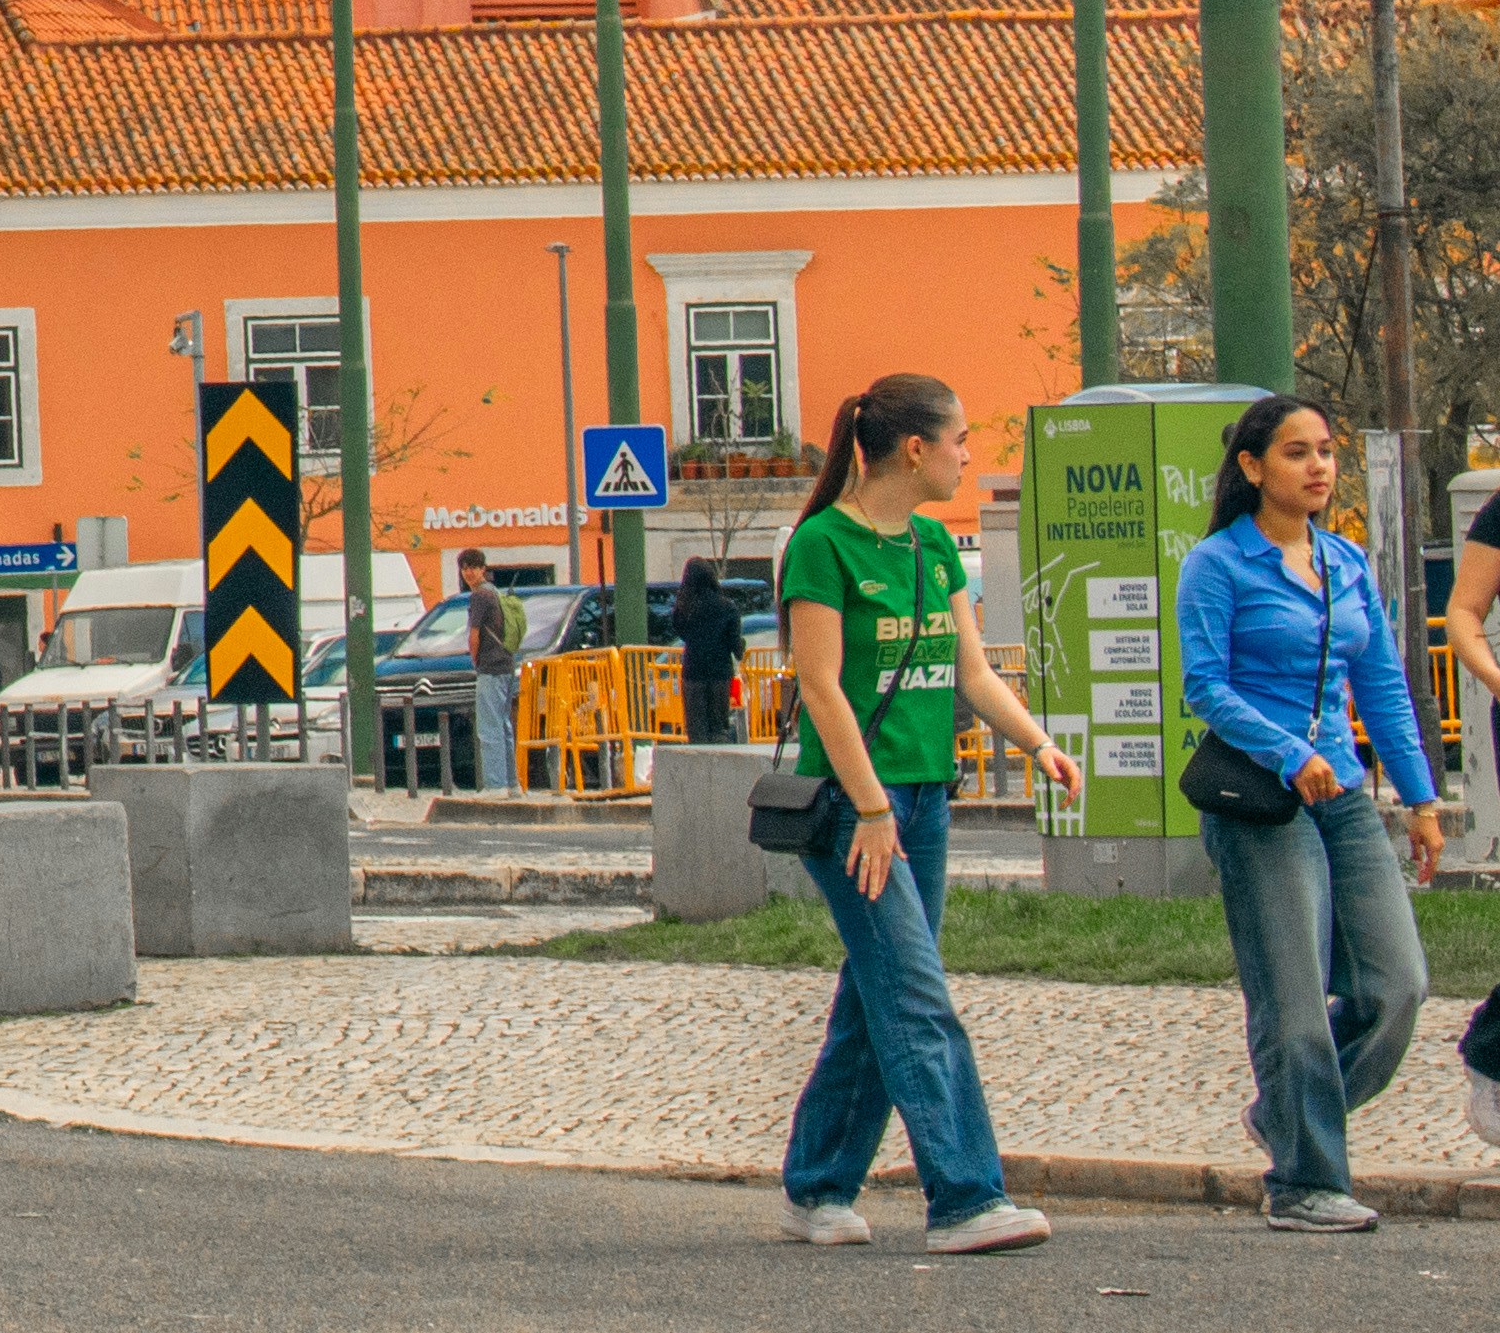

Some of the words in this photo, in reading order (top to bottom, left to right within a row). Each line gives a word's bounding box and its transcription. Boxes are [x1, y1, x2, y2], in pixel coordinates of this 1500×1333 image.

[1058, 419, 1091, 432] LISBOA
[1066, 462, 1143, 493] NOVA
[1067, 495, 1145, 523] Papeleira
[423, 503, 589, 530] McDonalds
[1047, 521, 1146, 541] INTELIGENTE
[1119, 583, 1148, 592] MOVIDO
[1126, 603, 1149, 611] SOLAR
[1115, 636, 1140, 644] SISTEMA
[1130, 688, 1152, 697] REDUZ
[1119, 699, 1125, 707] A
[1125, 699, 1153, 708] PEGADA
[1121, 741, 1155, 749] MELHORIA
